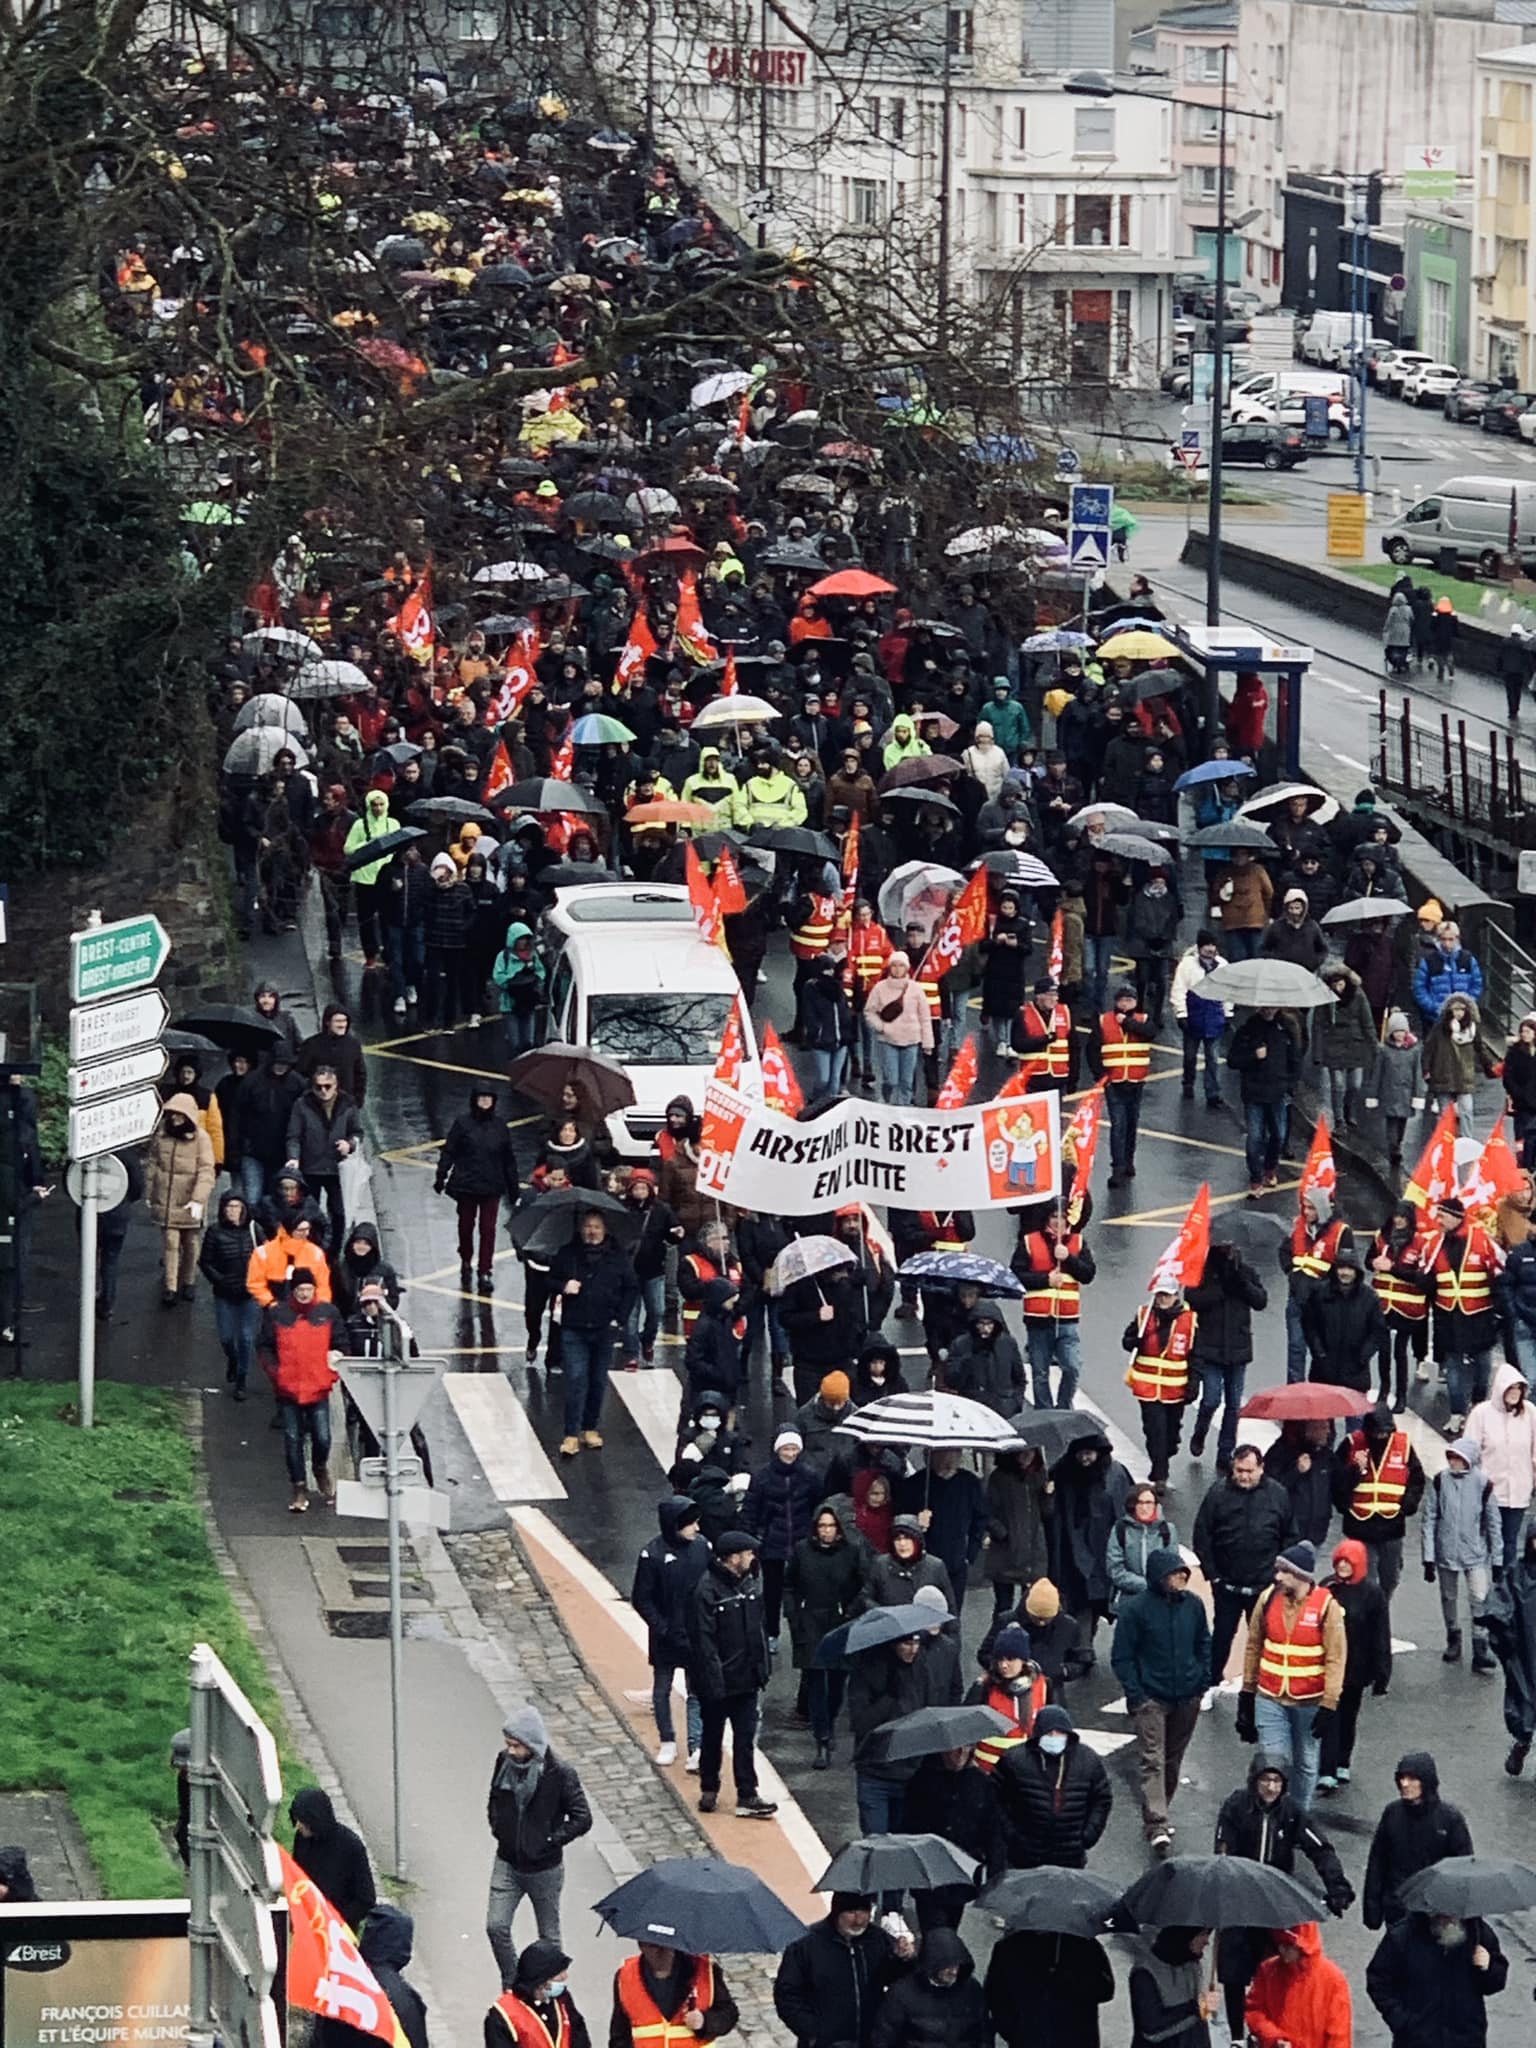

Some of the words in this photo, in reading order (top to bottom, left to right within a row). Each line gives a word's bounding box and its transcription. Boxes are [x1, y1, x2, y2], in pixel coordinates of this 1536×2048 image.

[750, 1120, 848, 1164] ARSENAL
[855, 1116, 880, 1149] DE
[889, 1122, 975, 1154] BREST
[813, 1164, 843, 1200] EN
[846, 1158, 906, 1193] LUTTE
[22, 1944, 62, 1961] Brest
[40, 2004, 124, 2024] FRANÇOIS
[38, 2029, 61, 2043] ET
[61, 2023, 130, 2045] L'ÉQUIPE
